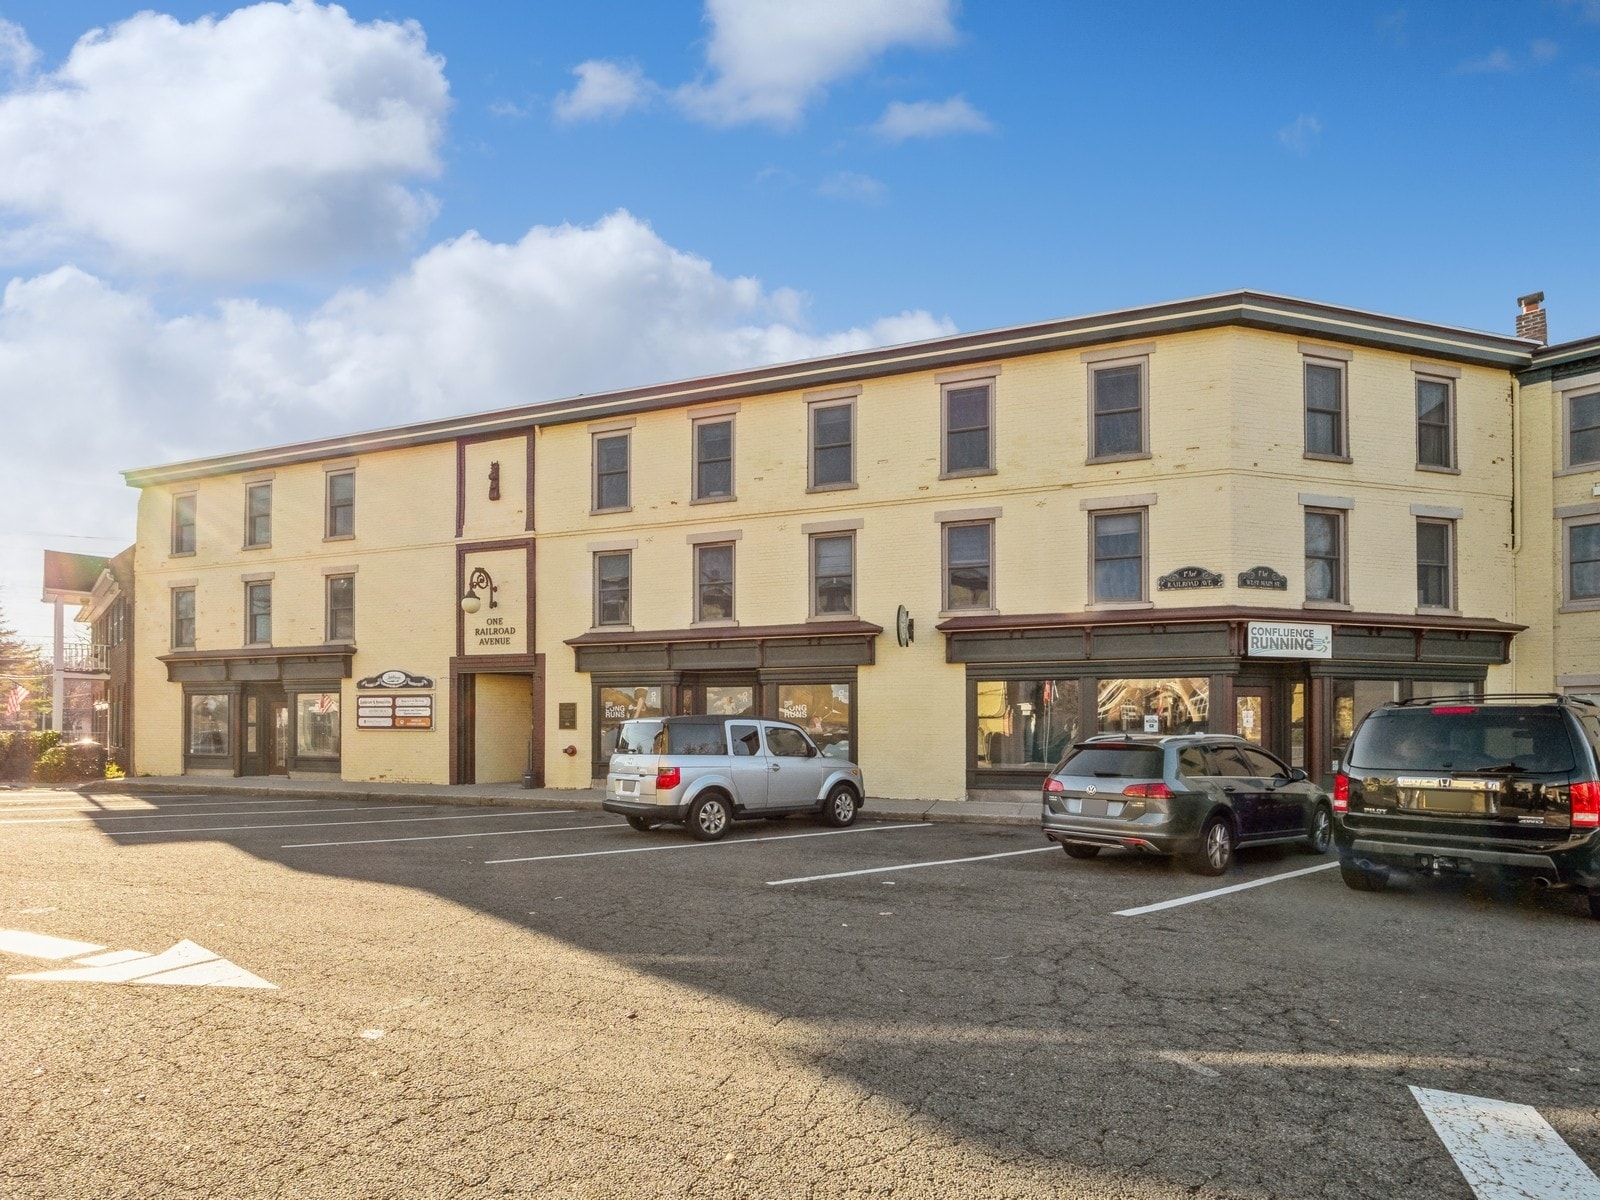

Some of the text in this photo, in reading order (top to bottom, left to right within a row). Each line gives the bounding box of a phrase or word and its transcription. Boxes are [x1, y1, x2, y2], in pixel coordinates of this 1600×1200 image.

[1167, 580, 1199, 588] RAILROAD
[486, 617, 504, 626] ONE
[475, 627, 516, 636] RAILROAD
[1250, 626, 1315, 639] CONFLUENCE
[479, 637, 511, 646] AVENUE
[1250, 636, 1314, 651] RUNNING
[1363, 807, 1388, 815] PILOT
